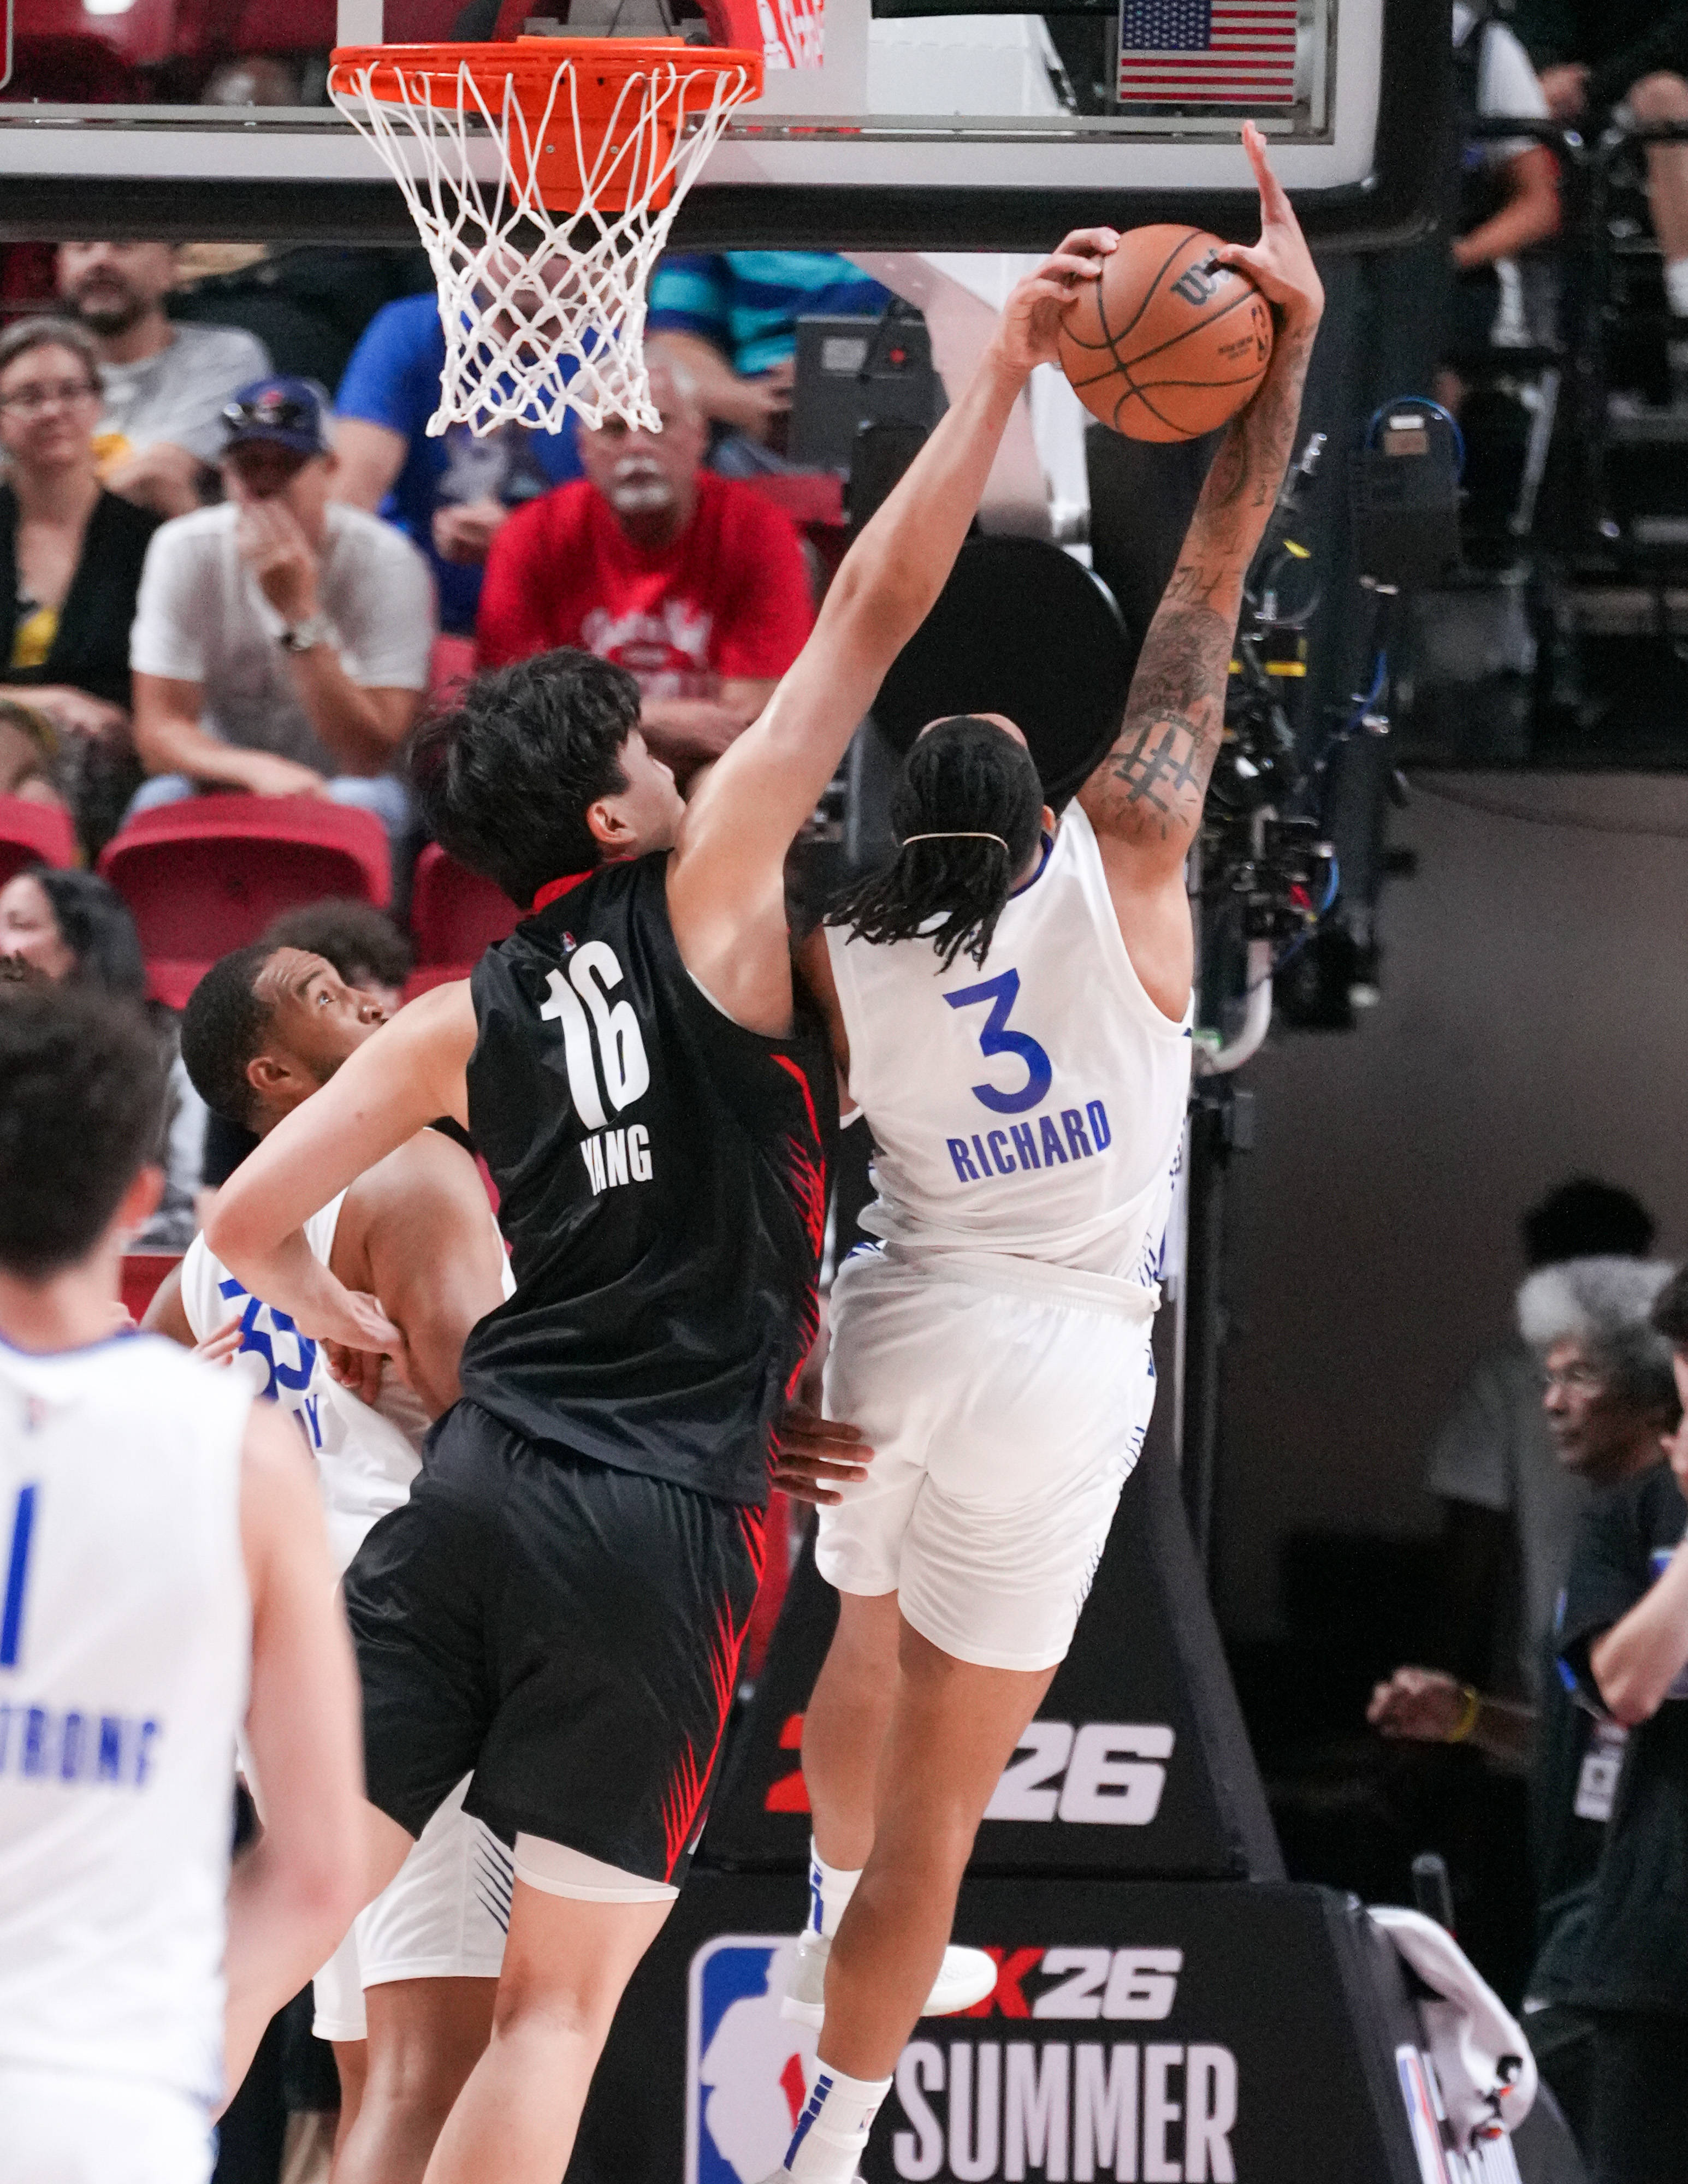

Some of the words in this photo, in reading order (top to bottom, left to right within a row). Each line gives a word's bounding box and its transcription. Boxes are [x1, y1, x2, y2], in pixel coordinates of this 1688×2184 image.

[540, 940, 650, 1131] 16
[942, 968, 1052, 1114] 3
[580, 1124, 653, 1196] YANG
[946, 1100, 1112, 1183] RICHARD
[939, 1946, 1183, 2020] K26
[893, 2040, 1238, 2183] SUMMER
